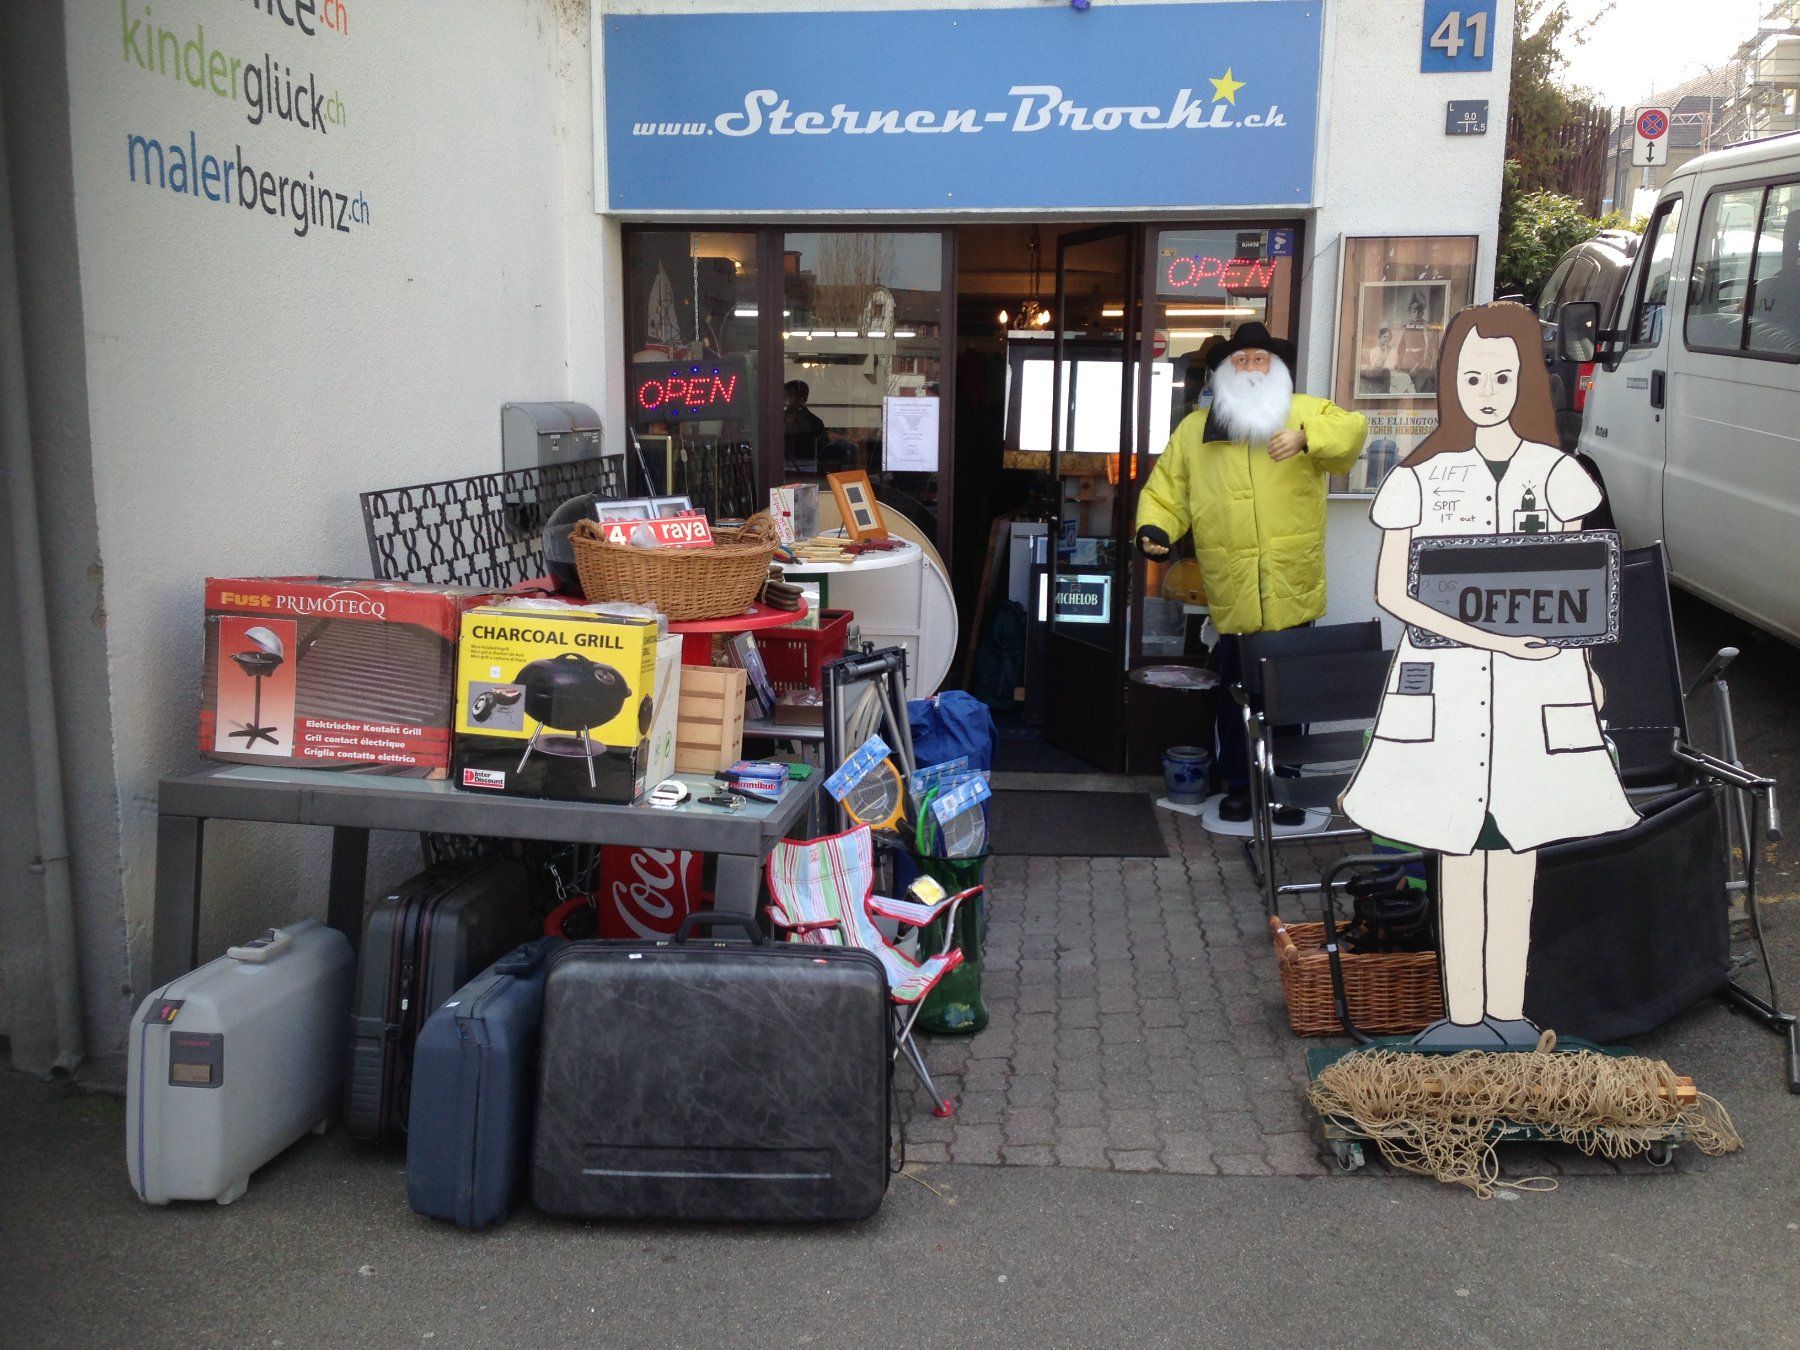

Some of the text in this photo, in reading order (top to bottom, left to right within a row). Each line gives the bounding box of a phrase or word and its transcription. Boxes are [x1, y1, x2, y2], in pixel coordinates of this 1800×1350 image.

[1430, 11, 1488, 58] 41
[120, 0, 346, 134] kinderglück.ch
[127, 131, 370, 237] malerberginz.ch
[1168, 256, 1278, 288] OPEN
[638, 375, 737, 409] OPEN
[1428, 464, 1478, 482] LIFT
[1432, 499, 1461, 512] SPIT
[1441, 513, 1454, 523] IT
[609, 525, 627, 546] 4
[661, 521, 707, 542] raya
[220, 591, 387, 620] Fust PRIMOTECQ
[1458, 586, 1591, 624] OFFEN
[471, 625, 569, 646] CHARCOAL
[574, 632, 624, 650] GRILL
[305, 734, 322, 742] Gril
[324, 736, 358, 745] contact
[306, 720, 422, 736] Elektrischer Kontakt Grill
[304, 748, 335, 758] Griglia
